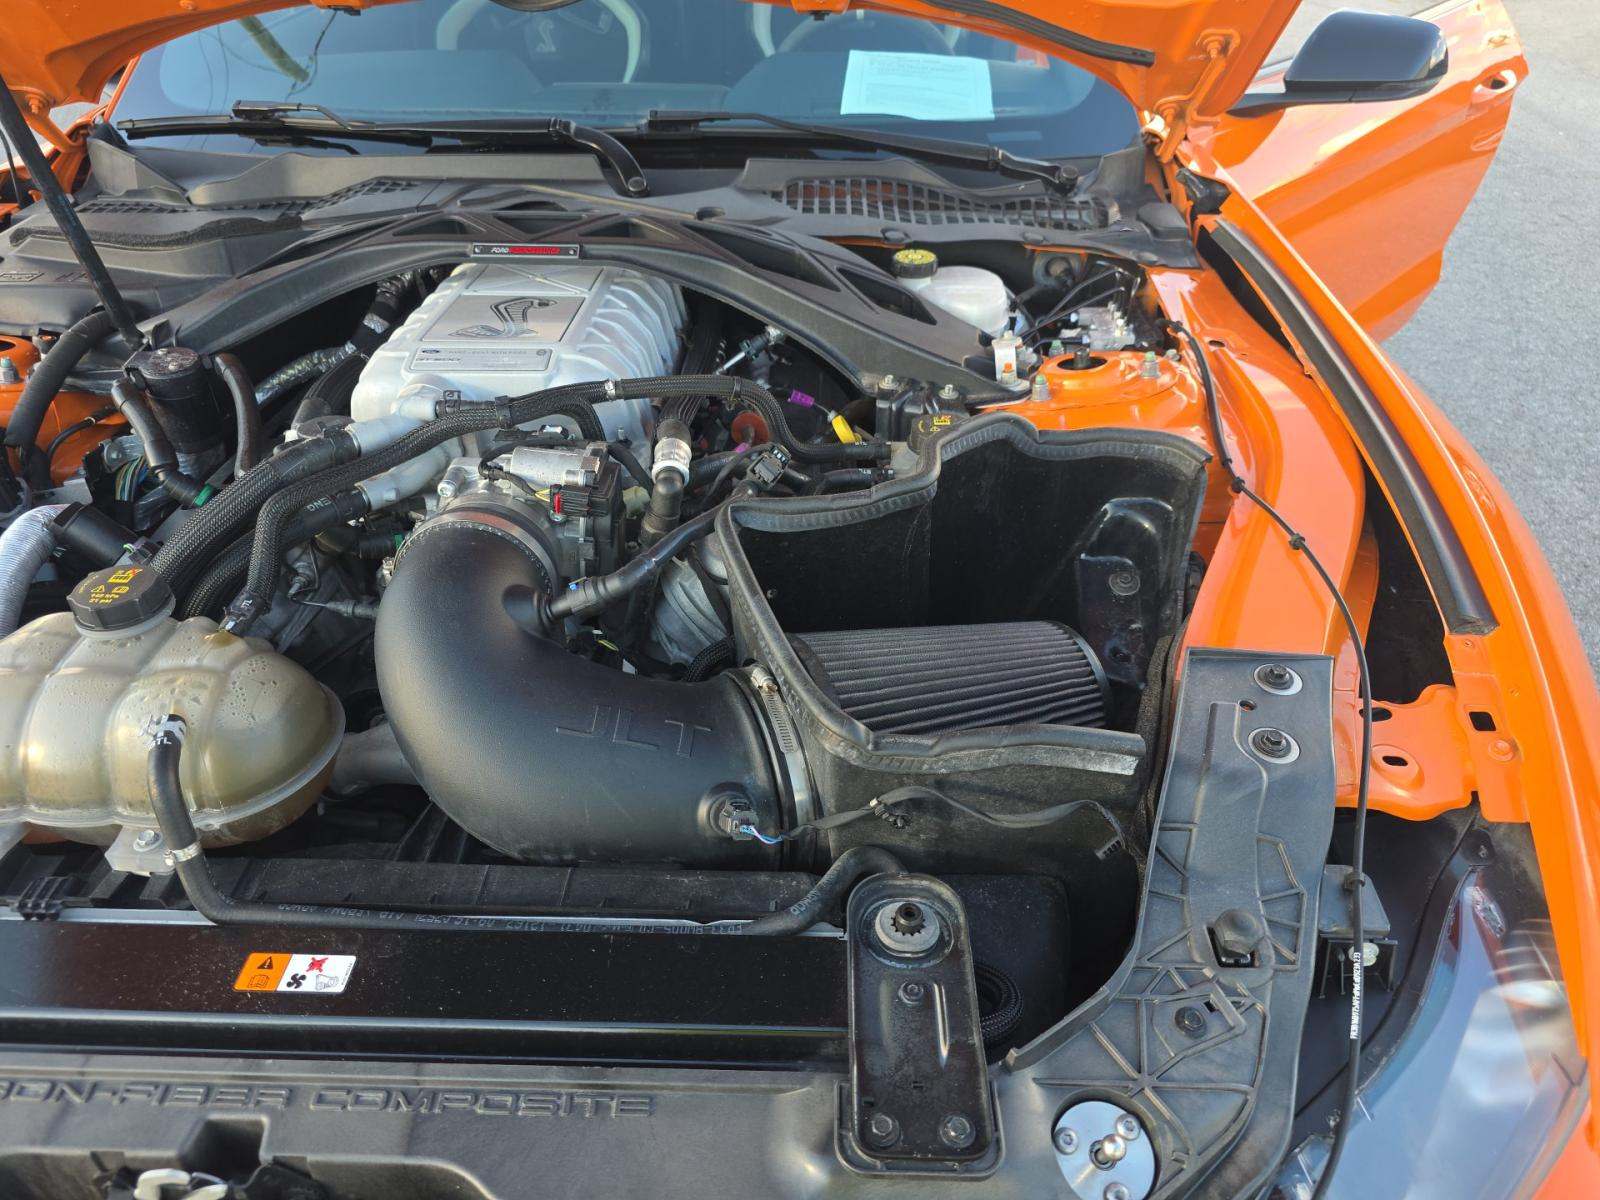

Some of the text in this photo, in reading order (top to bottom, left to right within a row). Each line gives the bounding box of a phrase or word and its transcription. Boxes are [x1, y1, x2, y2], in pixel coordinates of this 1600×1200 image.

[306, 496, 332, 512] ENG
[555, 704, 713, 759] JLT
[0, 1079, 655, 1119] ON-FIBER COMPOSITE
